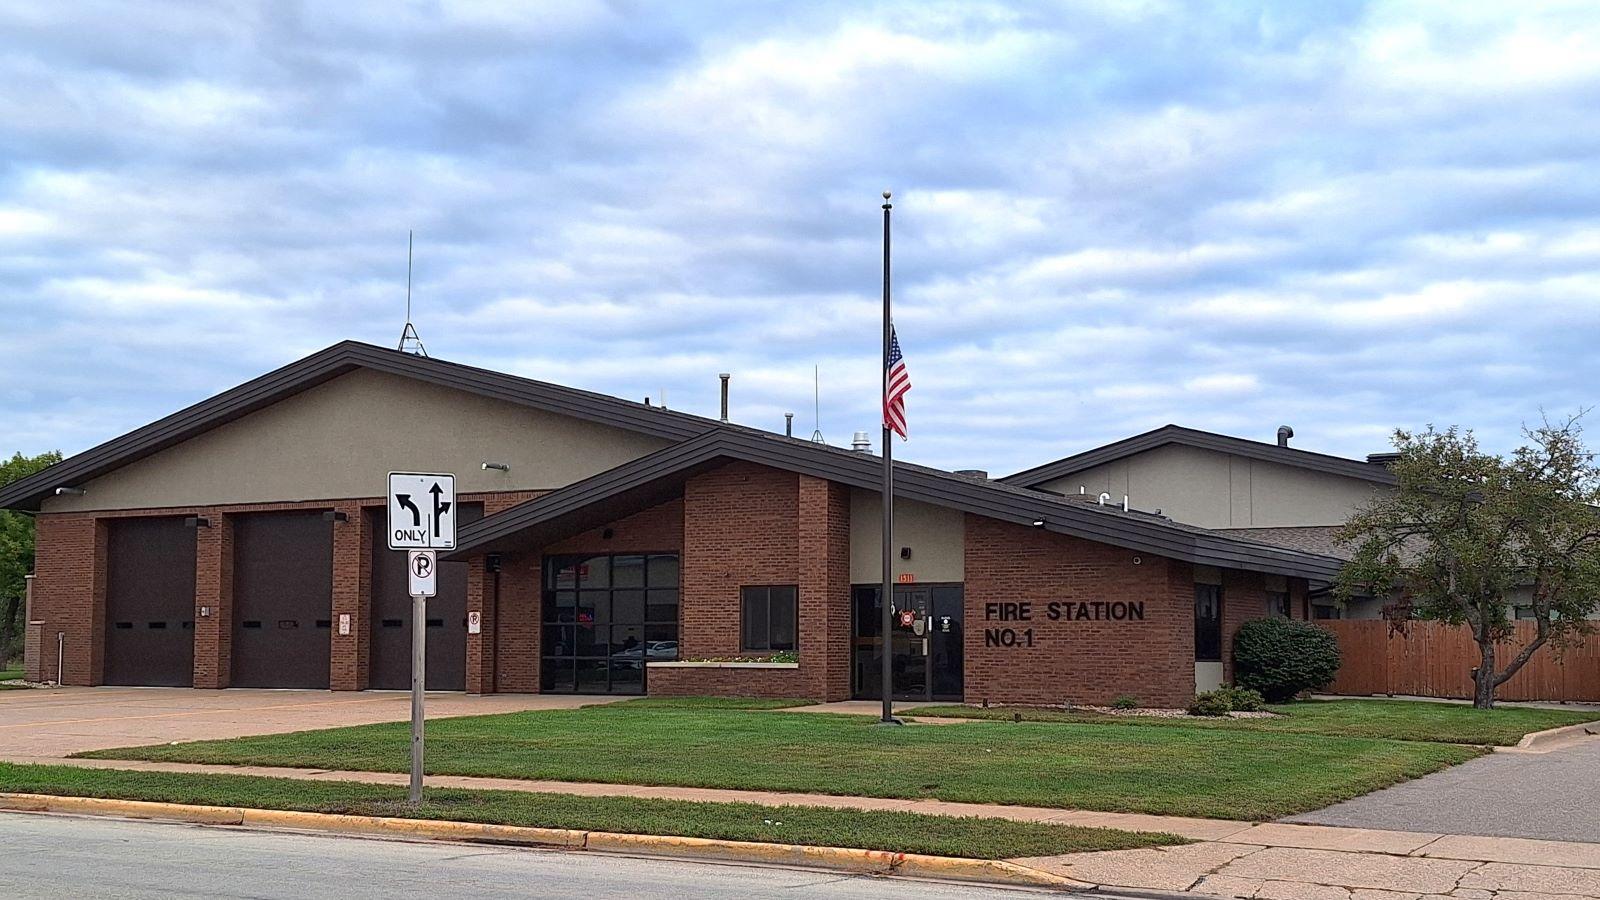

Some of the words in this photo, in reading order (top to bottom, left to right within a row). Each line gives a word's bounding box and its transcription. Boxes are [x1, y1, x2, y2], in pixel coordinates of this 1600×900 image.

[395, 529, 426, 541] ONLY
[417, 556, 430, 575] P
[985, 602, 1031, 621] FIRE
[1046, 601, 1144, 621] STATION
